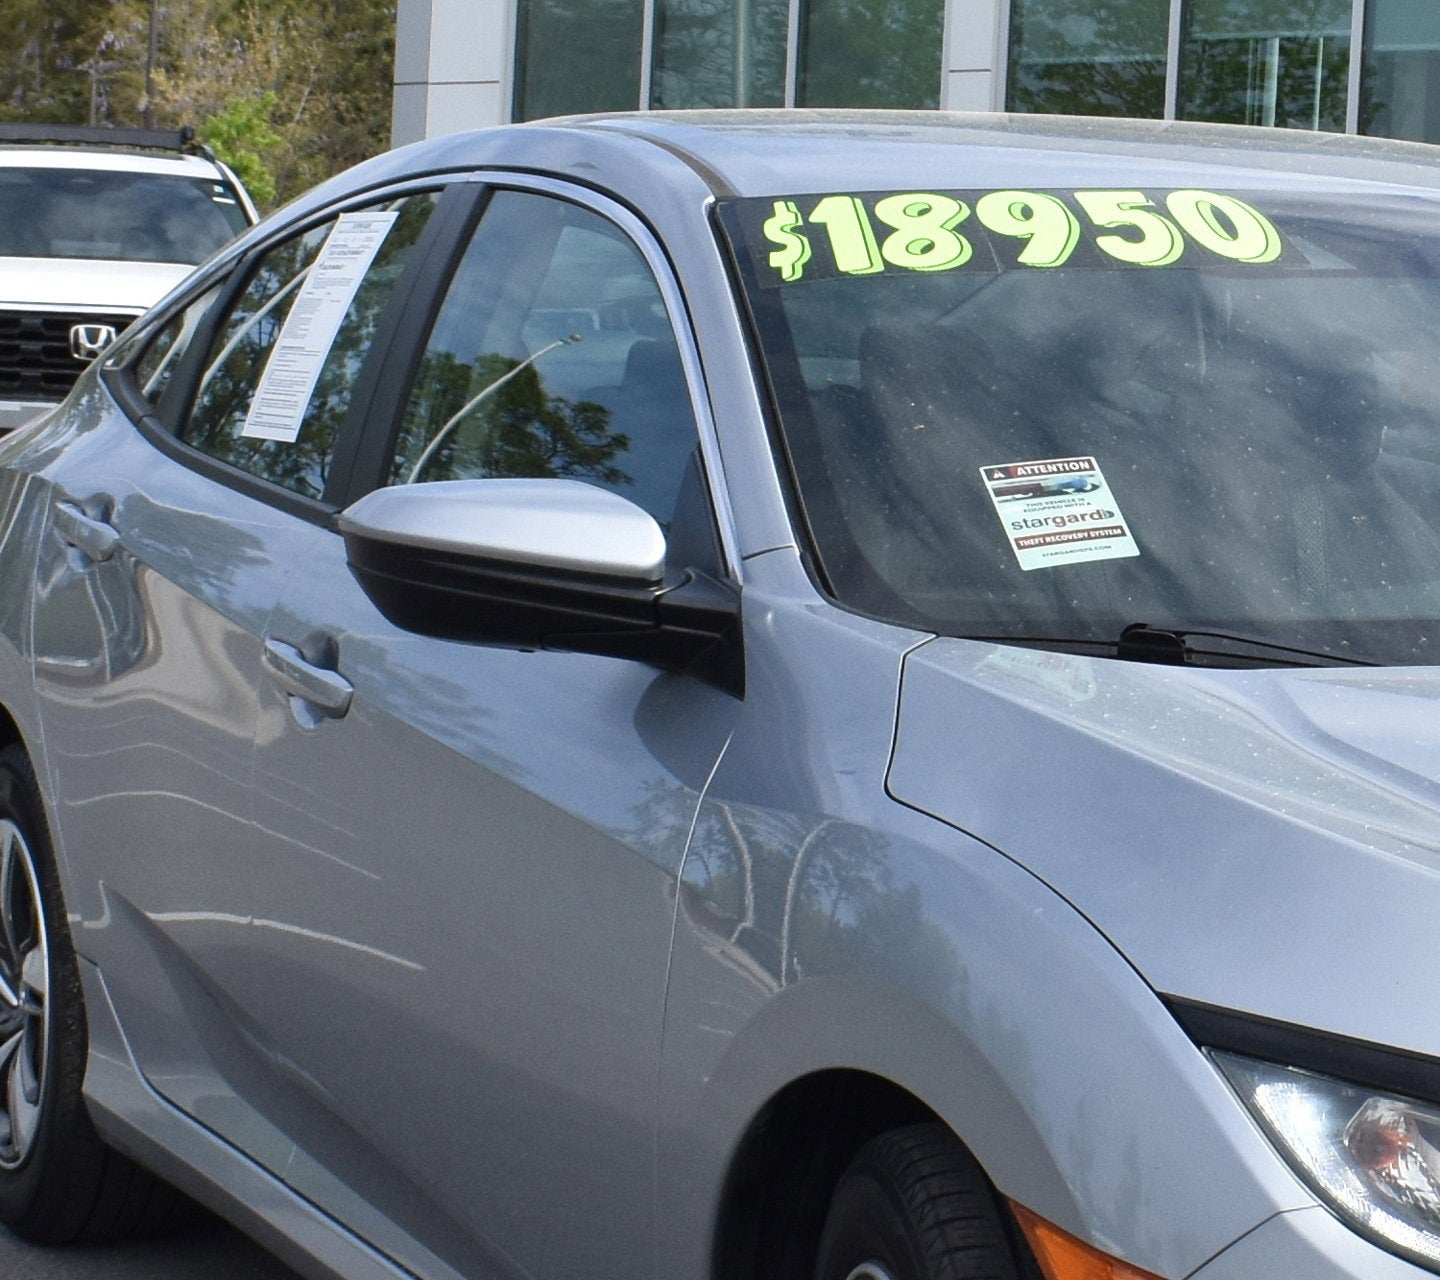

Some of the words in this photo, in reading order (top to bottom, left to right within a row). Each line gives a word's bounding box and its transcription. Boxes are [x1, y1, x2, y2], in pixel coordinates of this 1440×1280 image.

[763, 190, 1281, 282] $18950
[1017, 461, 1090, 476] ATTENTION
[1011, 509, 1103, 531] stargard
[1018, 539, 1044, 547] THEFT
[1046, 532, 1089, 543] RECOVERY
[1089, 529, 1121, 538] SYSTEM
